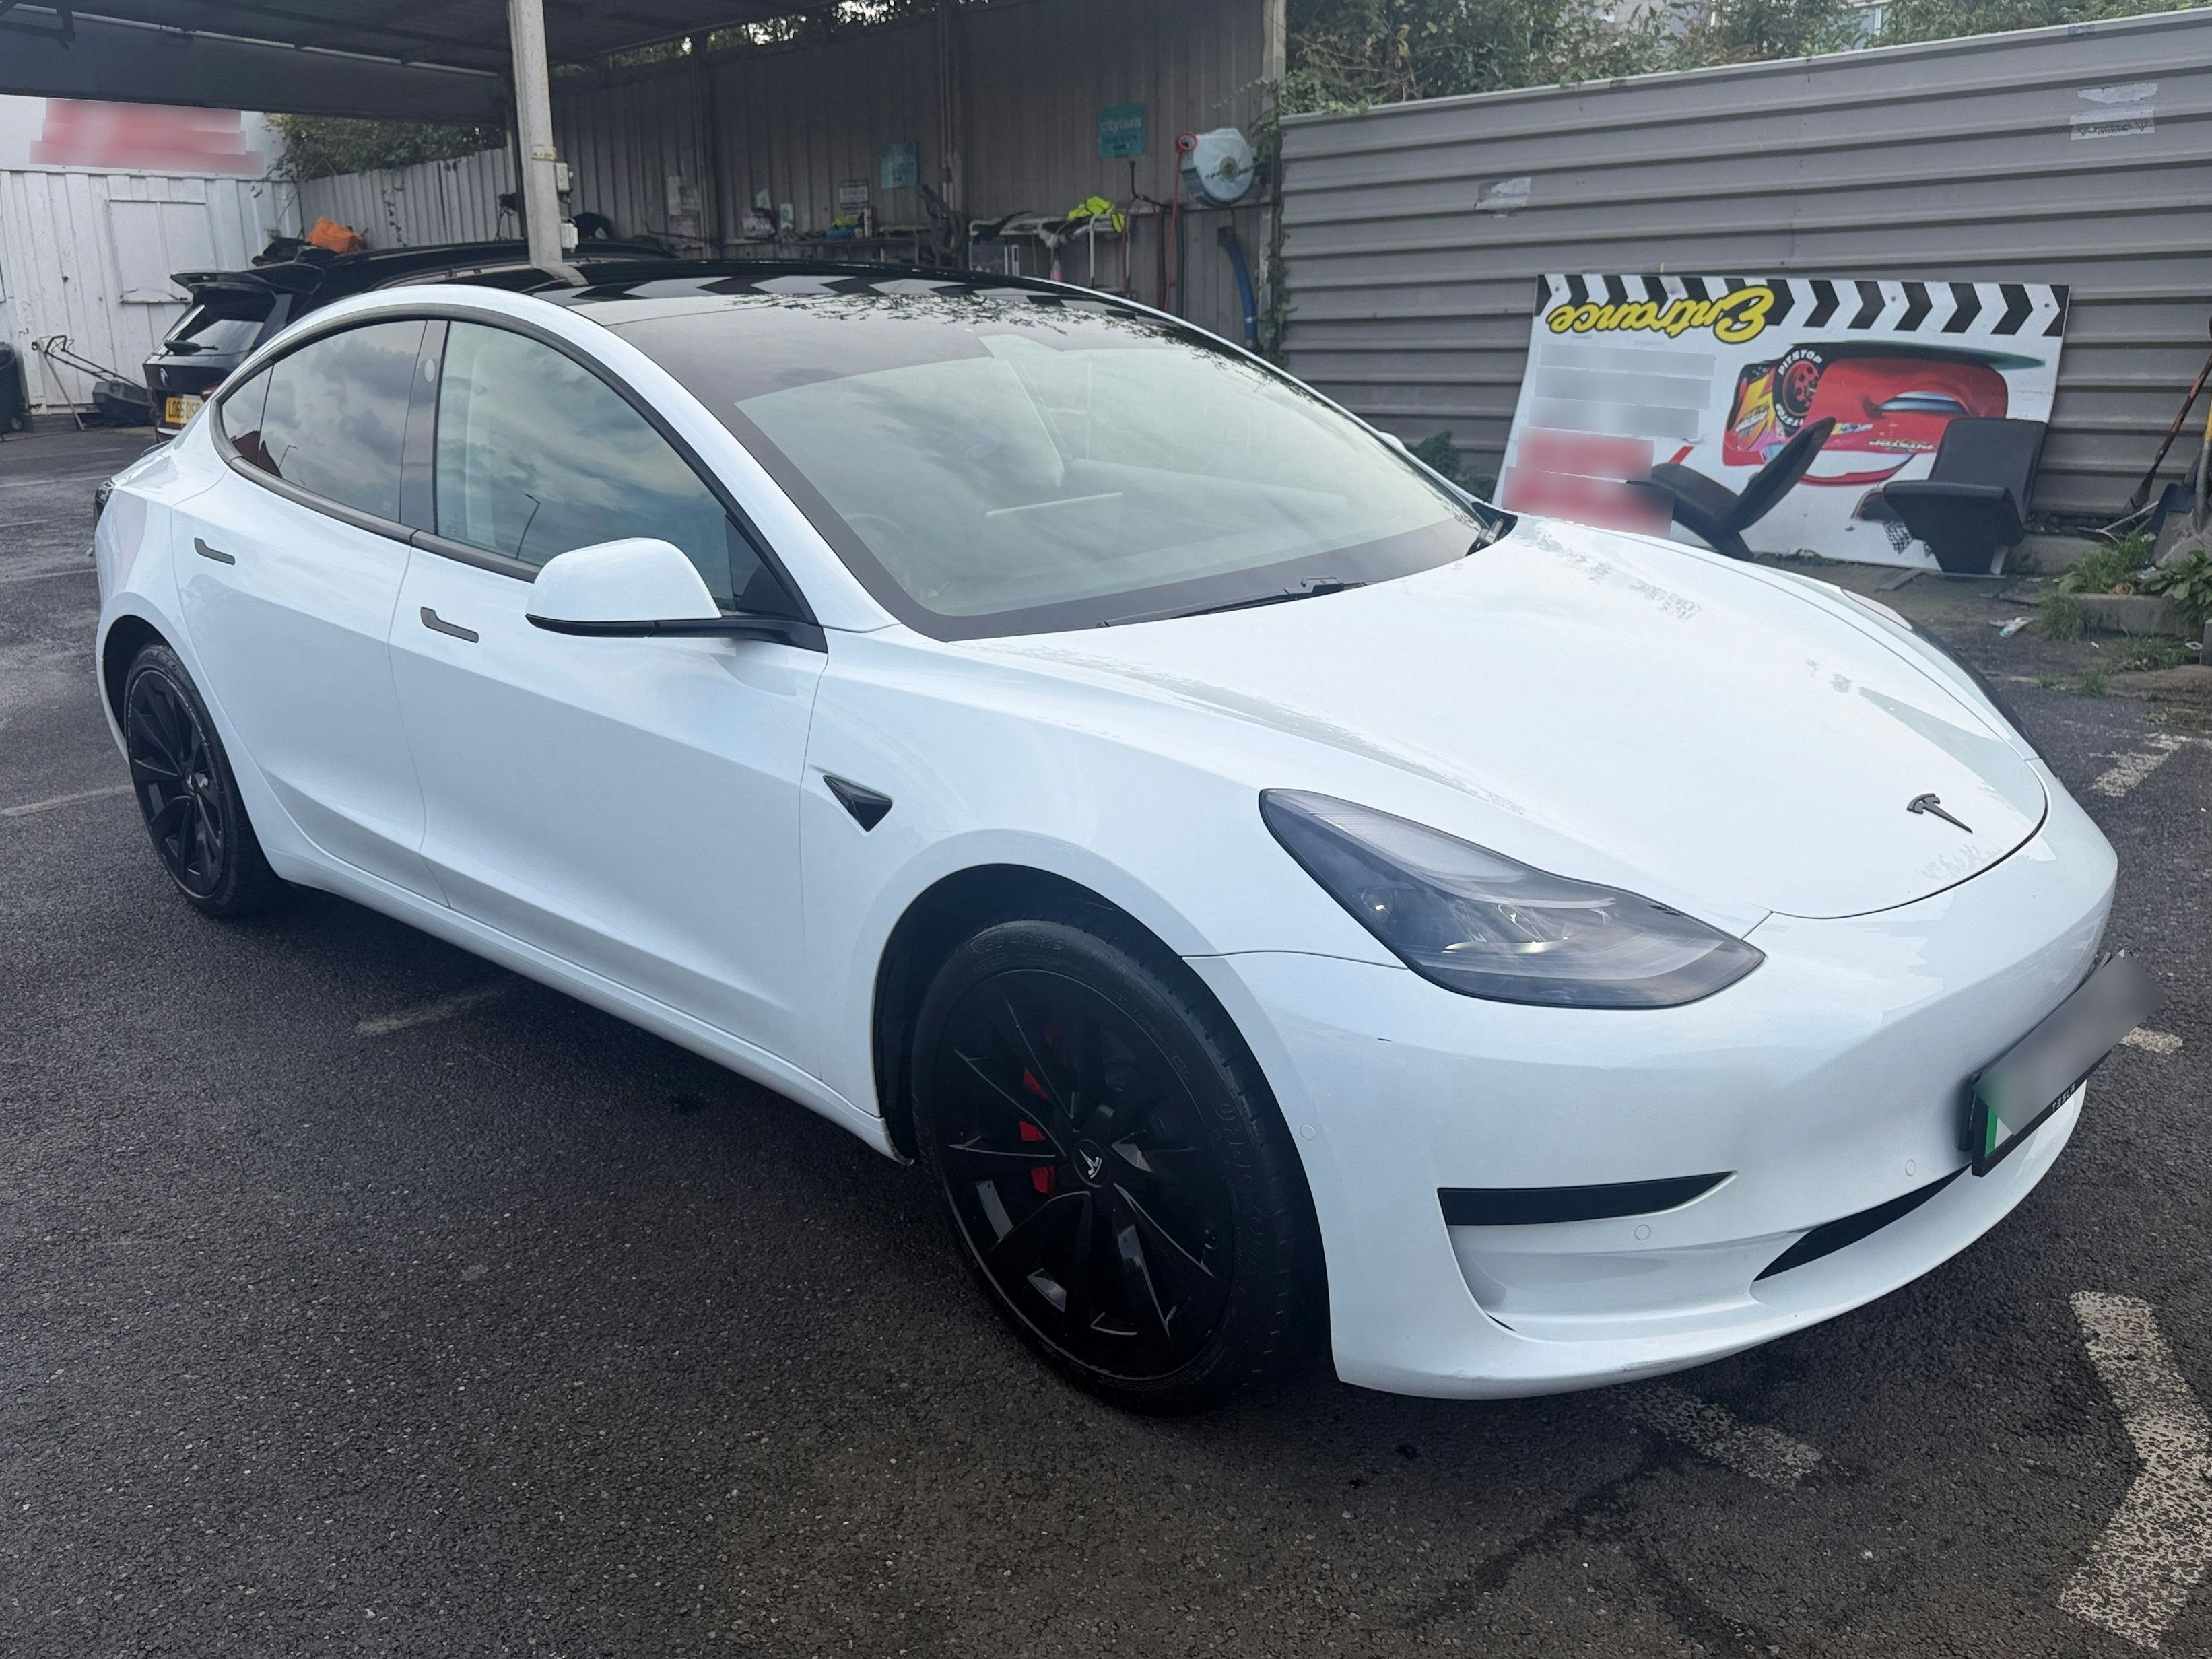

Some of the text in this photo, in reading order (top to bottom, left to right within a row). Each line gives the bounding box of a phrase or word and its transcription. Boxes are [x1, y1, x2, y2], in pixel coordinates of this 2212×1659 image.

[1547, 285, 1774, 343] Entrance
[1778, 349, 1823, 375] PITSTOP
[1775, 403, 1804, 427] ITSTOP
[2052, 1083, 2075, 1112] TESLA
